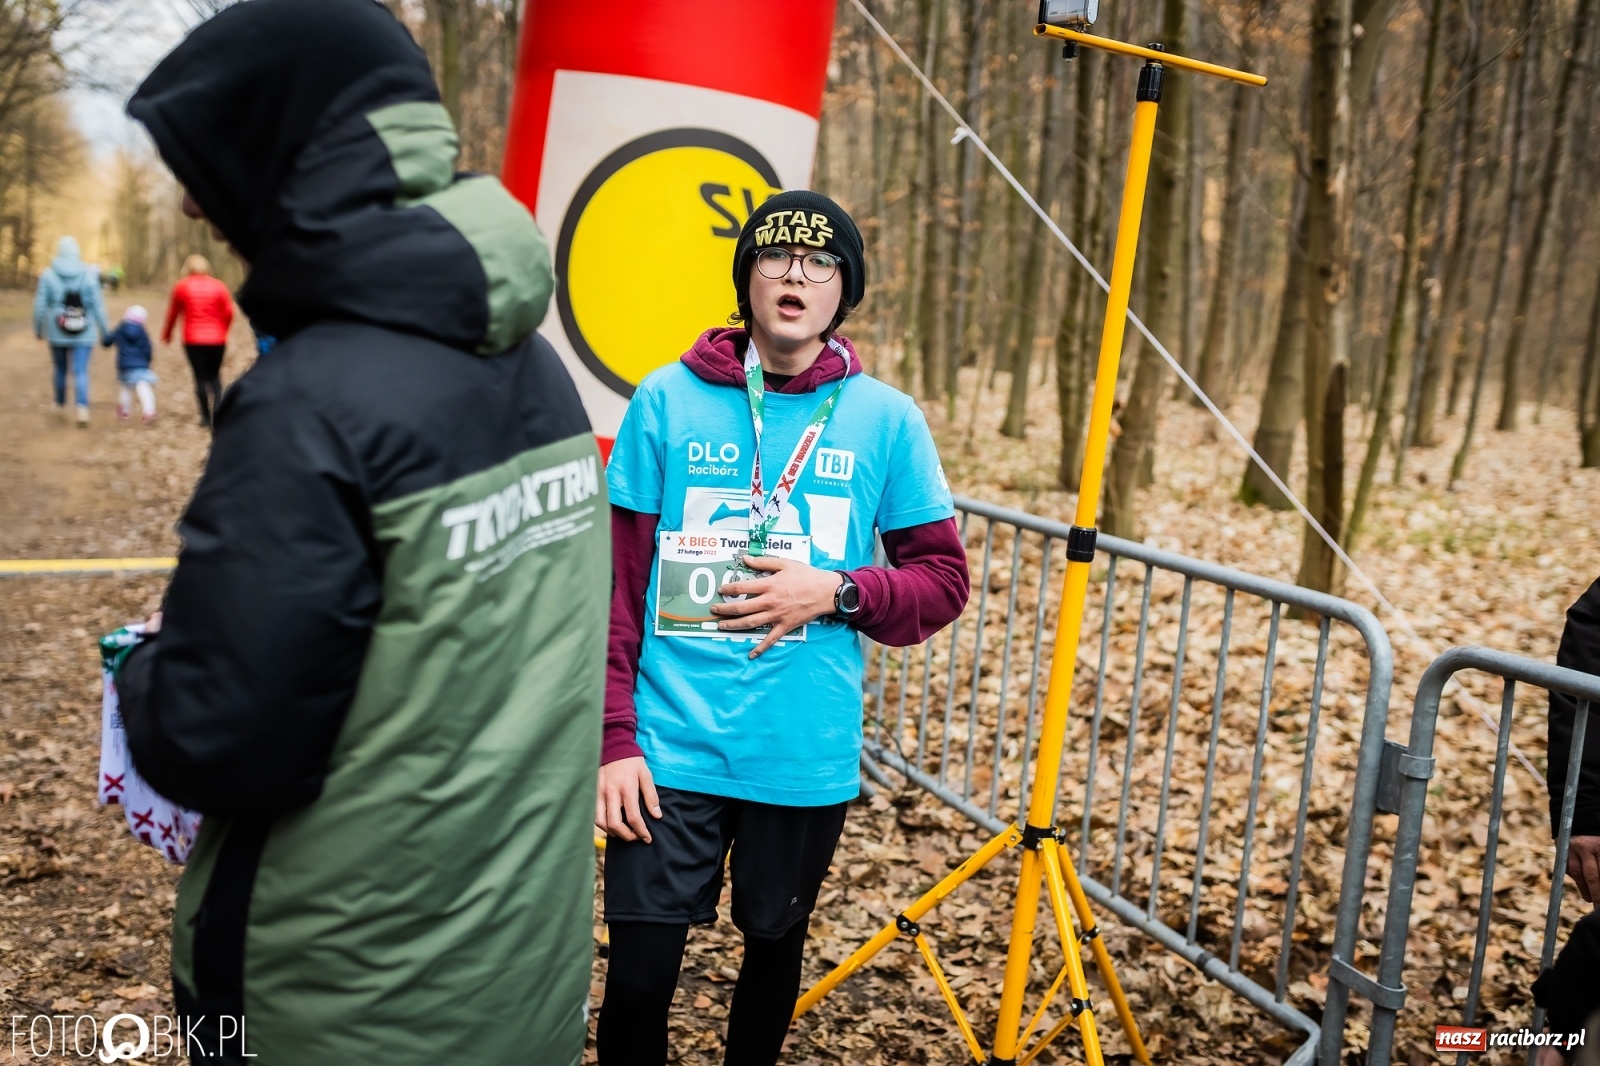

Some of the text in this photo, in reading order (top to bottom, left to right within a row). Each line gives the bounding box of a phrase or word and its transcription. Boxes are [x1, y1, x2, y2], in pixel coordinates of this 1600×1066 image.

[755, 210, 834, 234] STAR
[755, 226, 833, 248] WARS
[688, 441, 740, 463] DLO
[688, 464, 739, 477] Racibórz
[820, 452, 849, 475] TBI
[678, 536, 687, 547] X
[689, 536, 718, 547] BIEG
